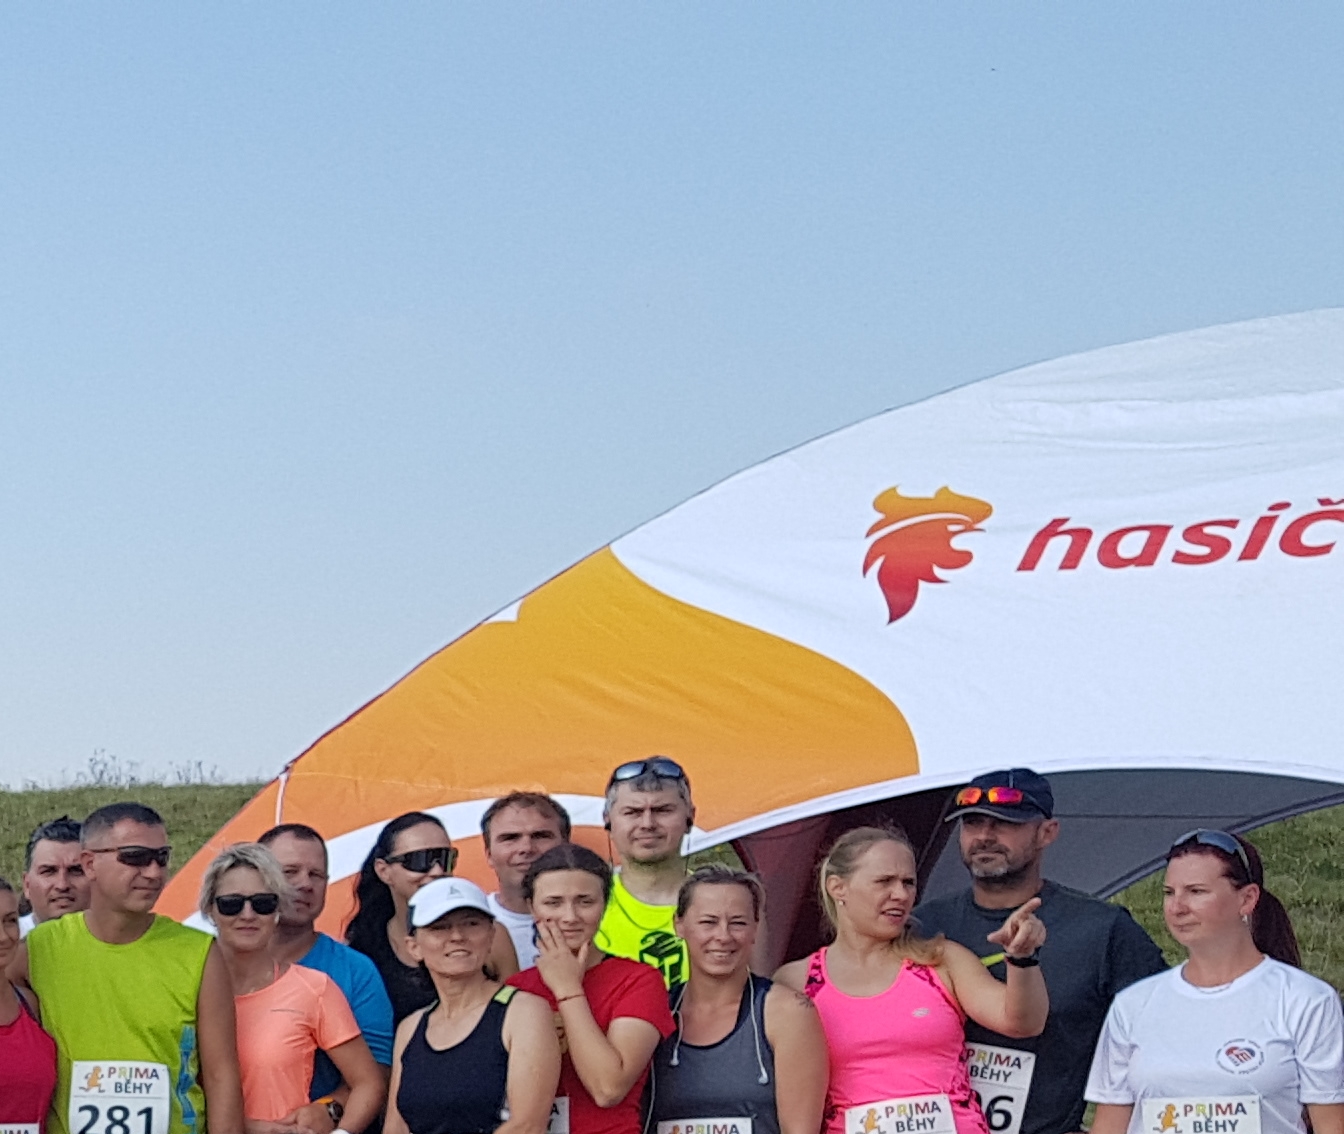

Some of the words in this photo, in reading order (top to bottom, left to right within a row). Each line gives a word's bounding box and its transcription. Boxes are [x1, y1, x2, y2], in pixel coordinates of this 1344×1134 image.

[966, 1049, 1022, 1069] PRIMA
[107, 1066, 160, 1080] PRIMA
[970, 1062, 1012, 1083] BĚHY
[114, 1078, 153, 1095] BĚHY
[885, 1100, 942, 1119] PRIMA
[1183, 1102, 1248, 1118] PRIMA
[895, 1117, 937, 1134] BĚHY
[1192, 1116, 1240, 1134] BĚHY
